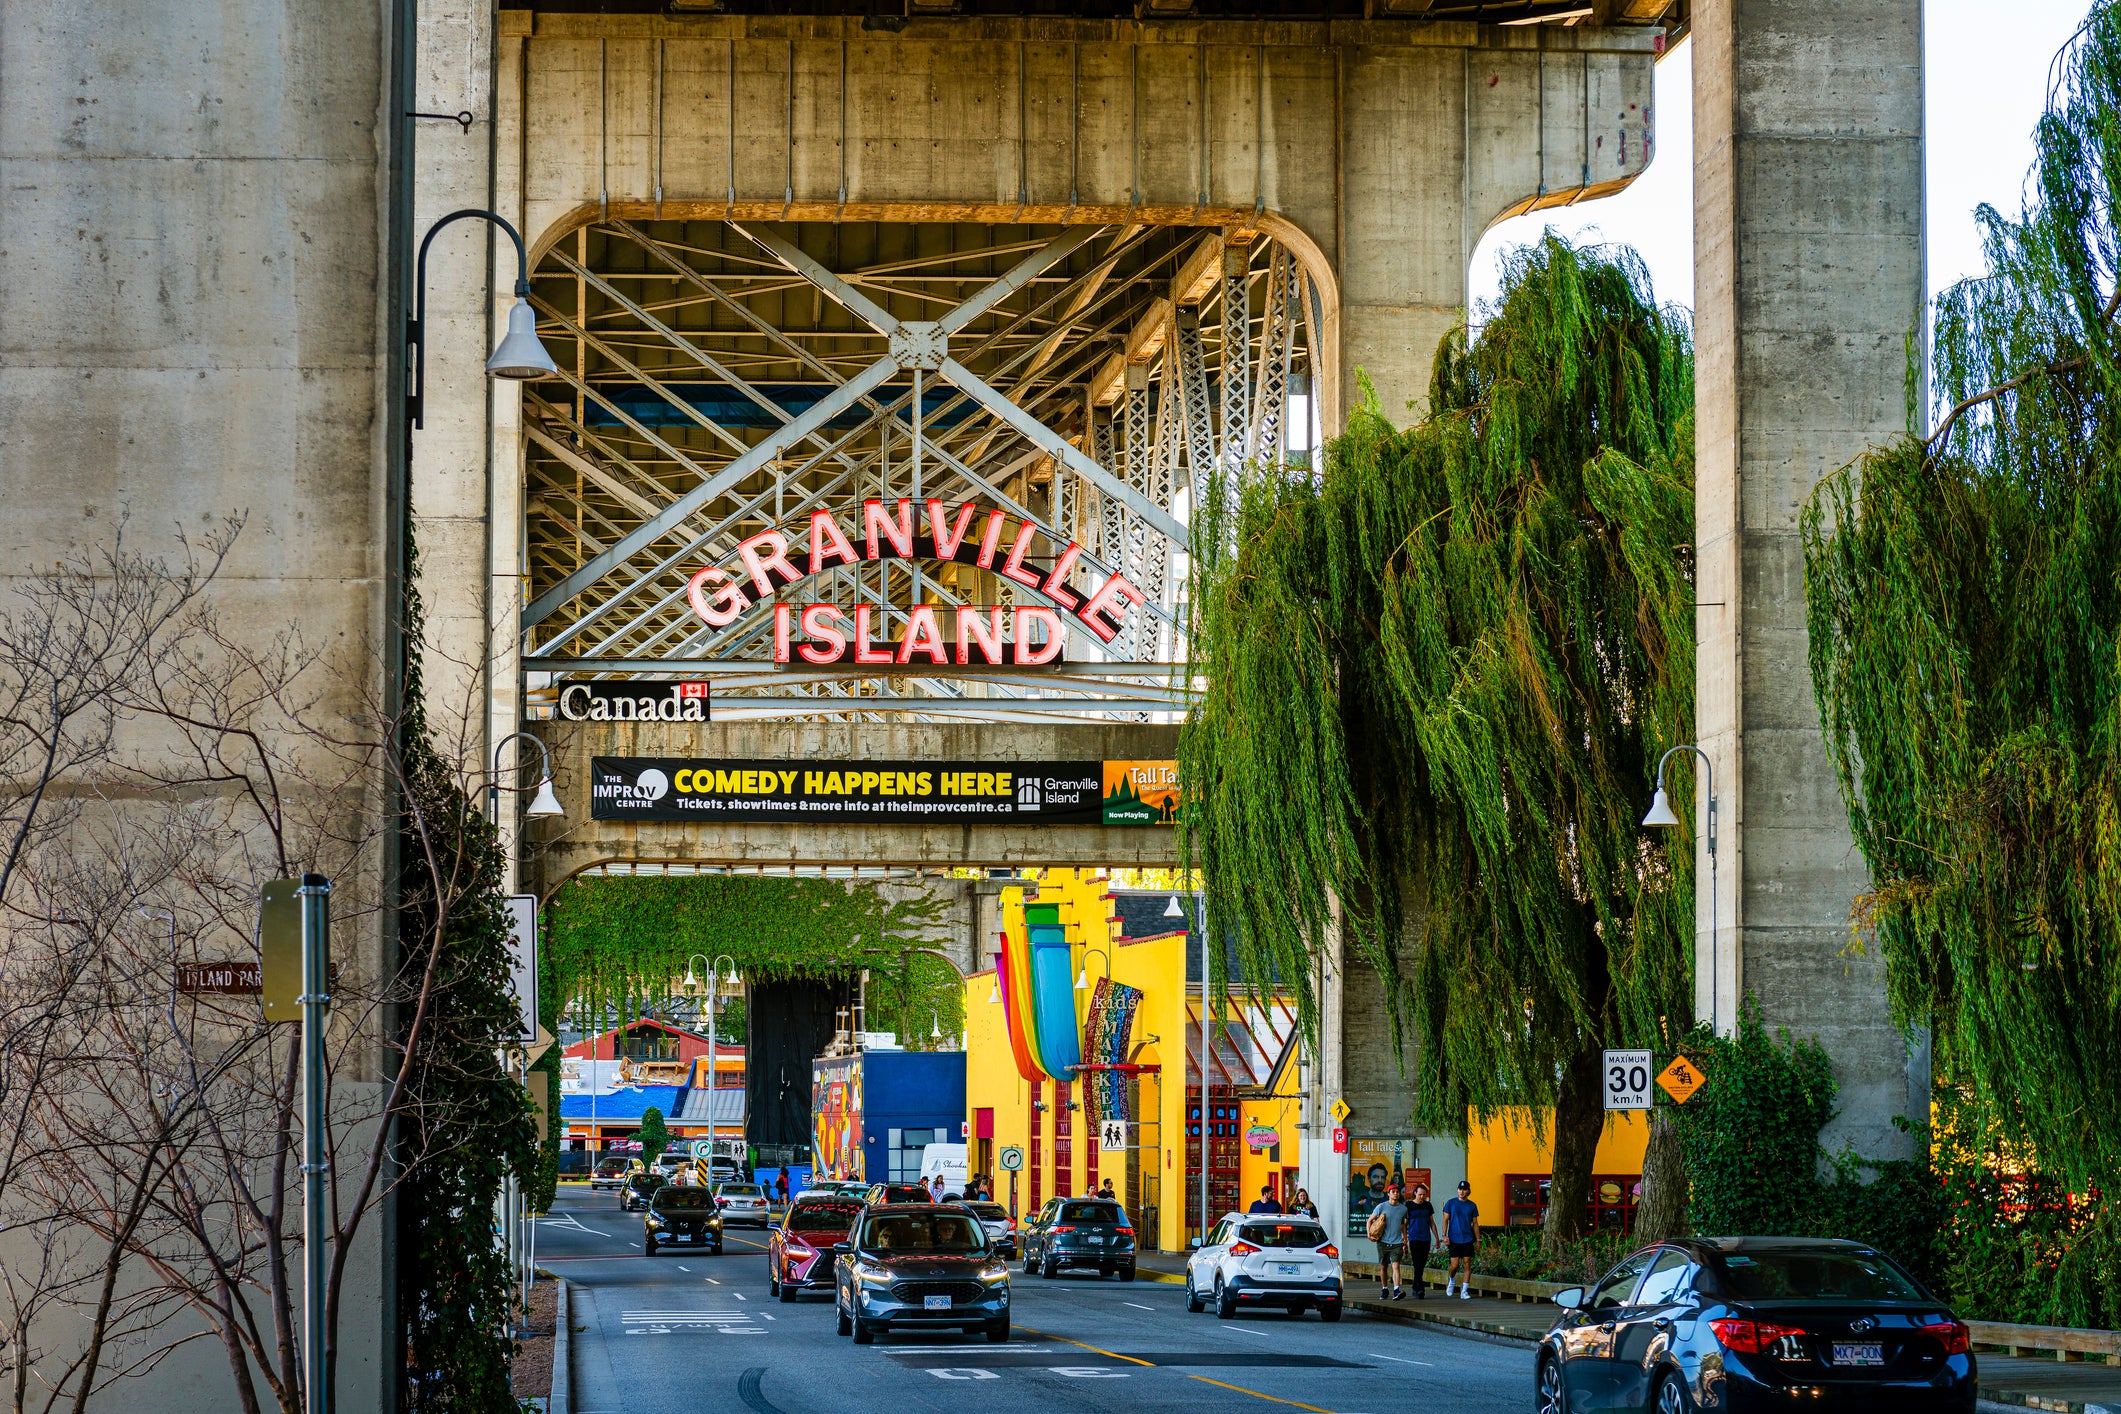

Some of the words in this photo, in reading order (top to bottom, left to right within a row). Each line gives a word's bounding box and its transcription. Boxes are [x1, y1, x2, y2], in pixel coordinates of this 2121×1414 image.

[687, 498, 1147, 643] GRANVILLE
[774, 602, 1063, 665] ISLAND
[559, 683, 706, 721] Canada
[603, 775, 622, 783] THE
[674, 769, 798, 794] COMEDY
[804, 771, 933, 796] HAPPENS
[940, 772, 1012, 796] HERE
[1130, 767, 1157, 784] Tall
[1044, 777, 1098, 790] Granville
[593, 785, 656, 798] IMPROV
[1045, 791, 1079, 804] Island
[616, 800, 653, 808] CENTRE
[676, 798, 726, 811] Tickets,
[727, 799, 797, 811] showtimes
[844, 800, 870, 811] info
[871, 801, 885, 811] at
[887, 801, 1012, 814] theimprovcentre.ca
[186, 970, 233, 987] ISLAND
[239, 970, 263, 987] PAR
[1094, 995, 1137, 1010] kids
[1608, 1065, 1647, 1093] 30
[1613, 1095, 1643, 1104] km/h
[1358, 1141, 1374, 1152] Tall
